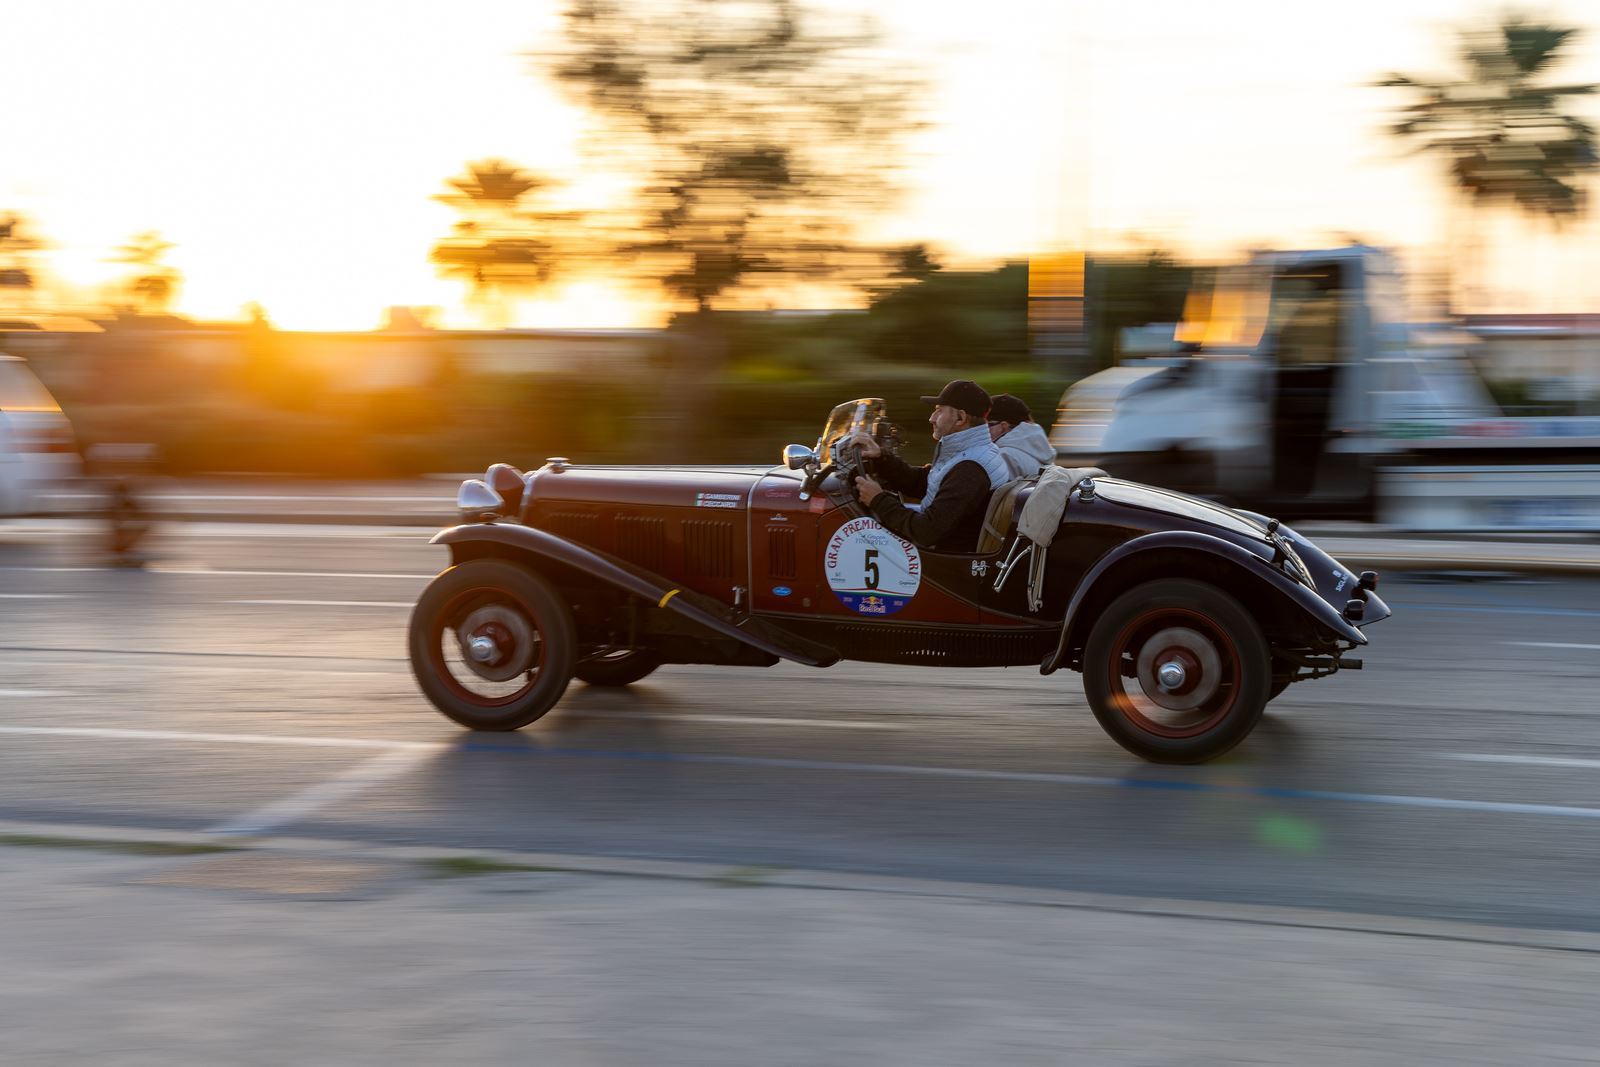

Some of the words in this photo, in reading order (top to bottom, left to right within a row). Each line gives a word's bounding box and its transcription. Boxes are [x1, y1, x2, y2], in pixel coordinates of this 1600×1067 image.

[828, 536, 844, 568] GRAN
[843, 520, 882, 537] PREMIO
[864, 550, 879, 589] 5
